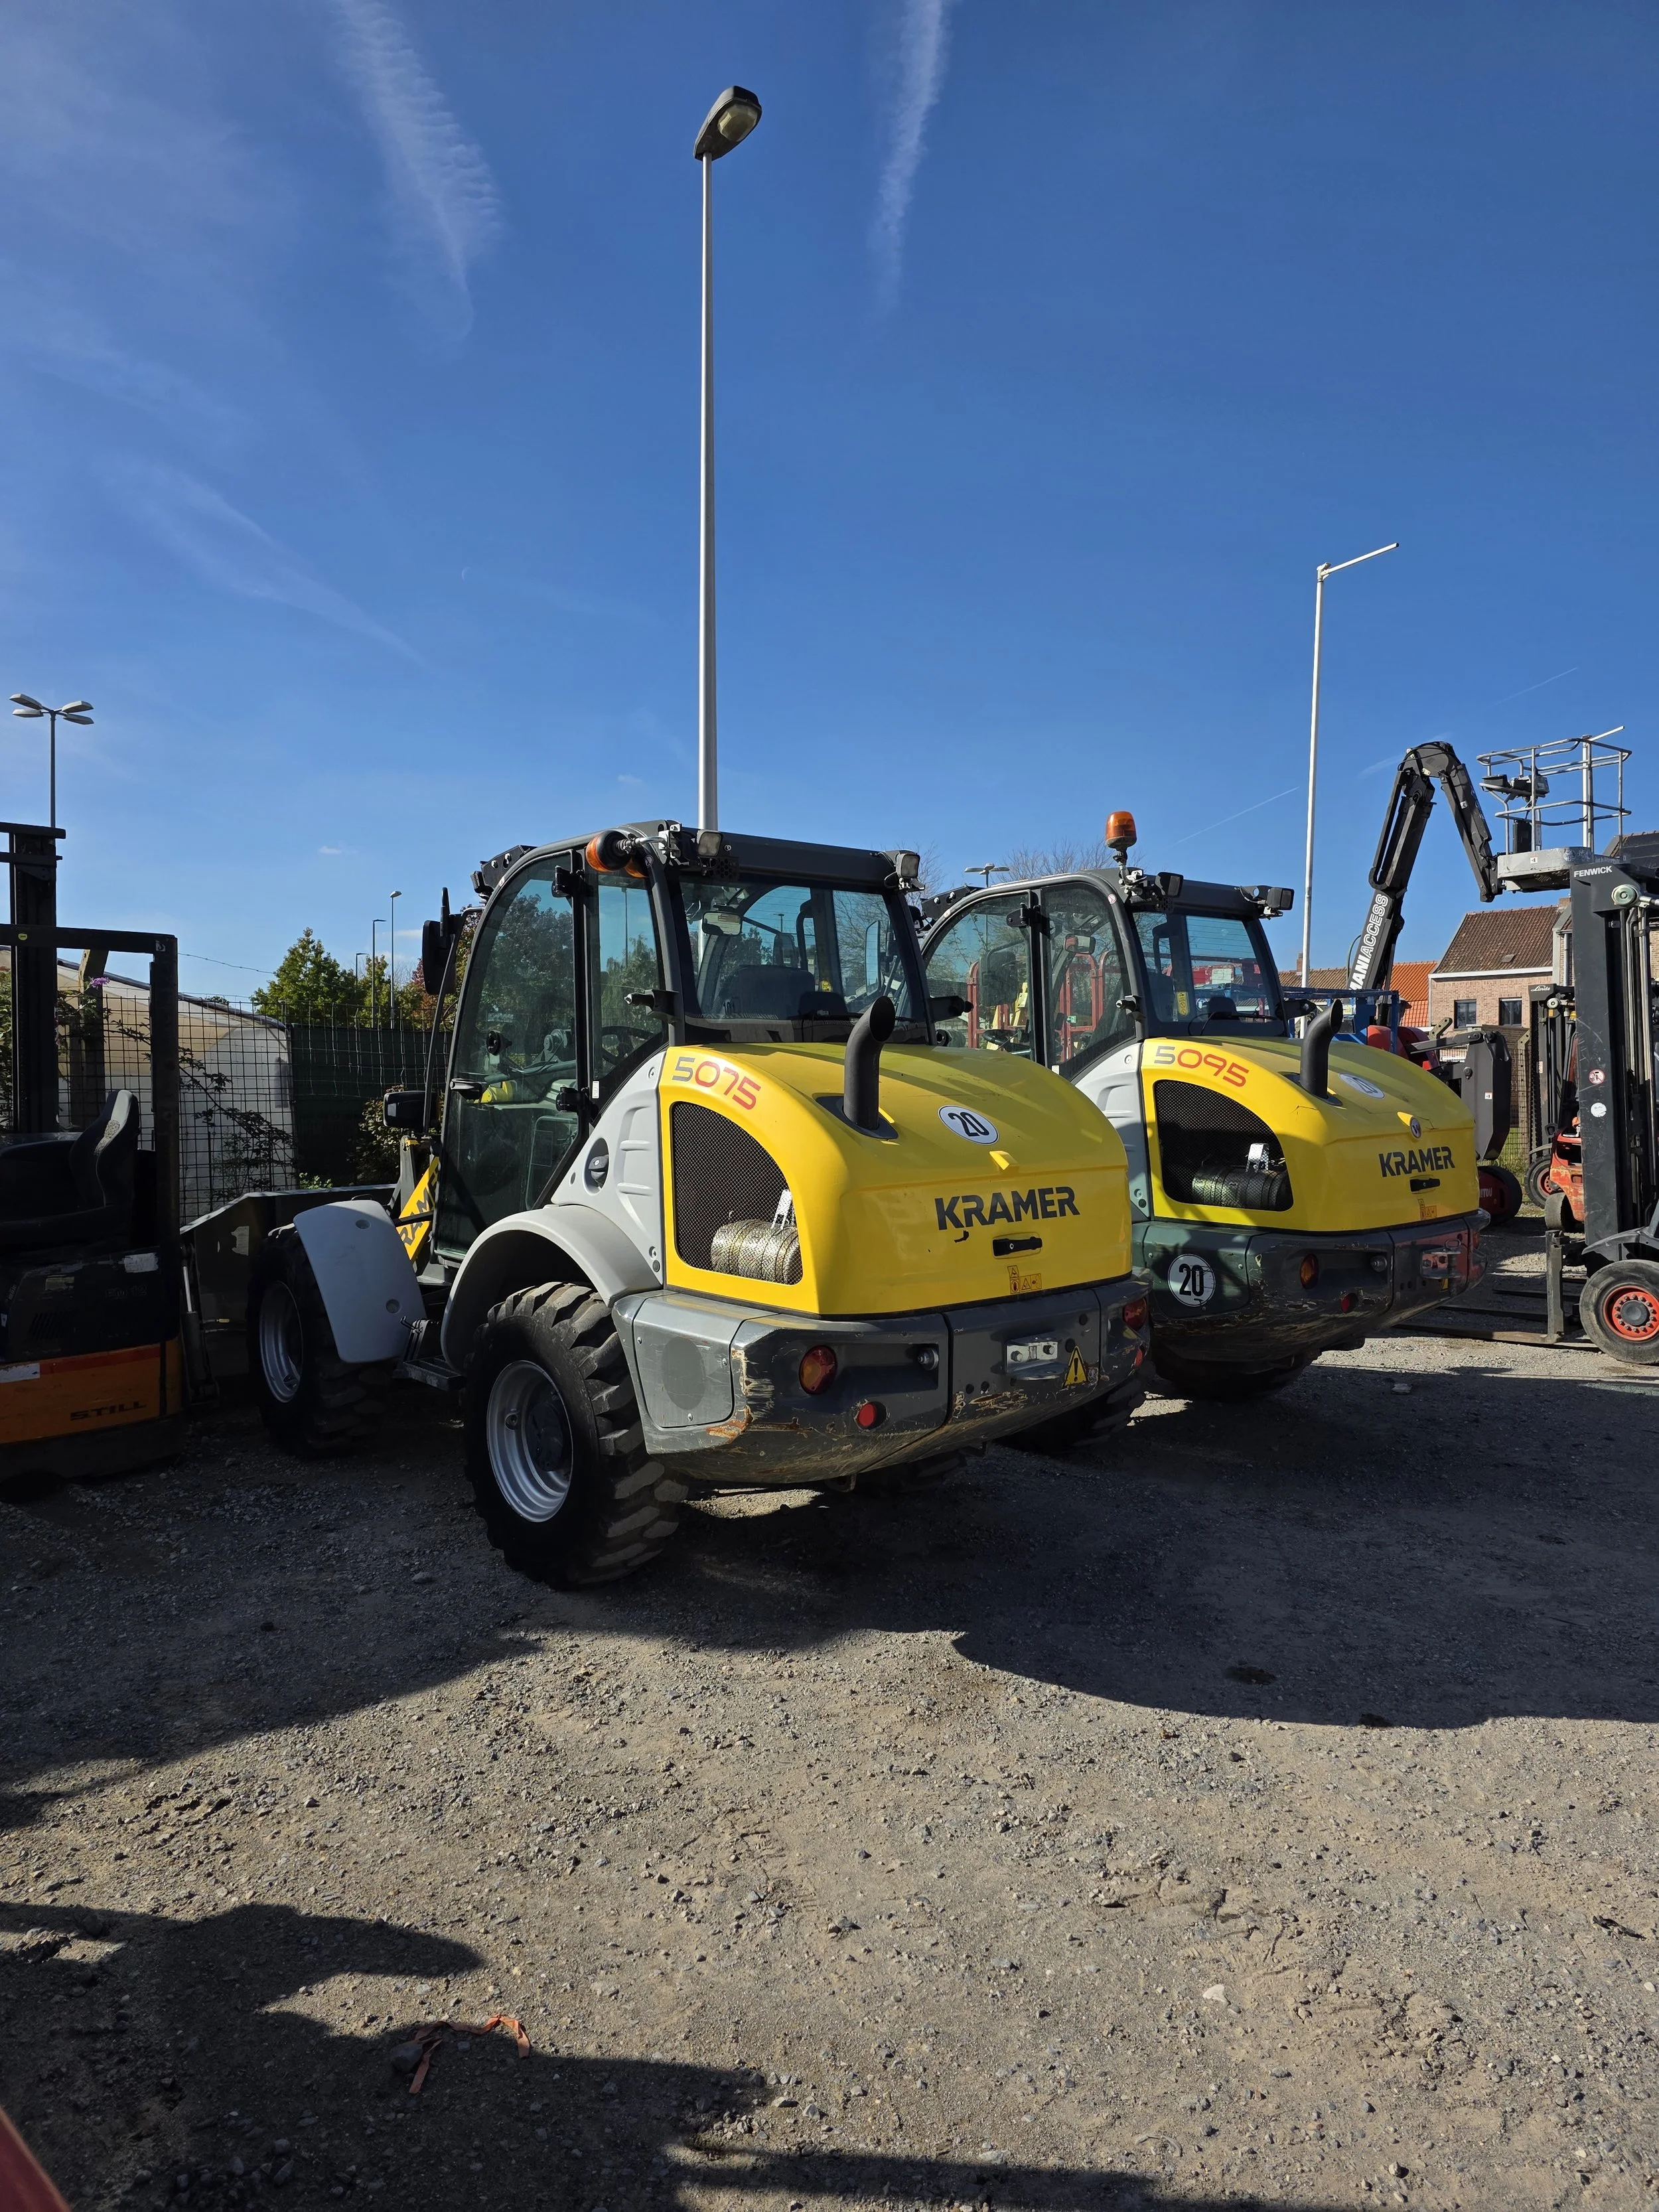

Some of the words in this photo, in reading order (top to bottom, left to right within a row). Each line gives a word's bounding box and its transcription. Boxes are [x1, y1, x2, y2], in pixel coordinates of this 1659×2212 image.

[1573, 865, 1613, 877] FENWICK
[1153, 1046, 1250, 1087] 5095
[672, 1057, 761, 1110] 5075
[947, 1111, 990, 1138] 20
[1378, 1145, 1455, 1177] KRAMER
[935, 1186, 1080, 1231] KRAMER
[1179, 1263, 1204, 1297] 20
[70, 1400, 147, 1422] STILL
